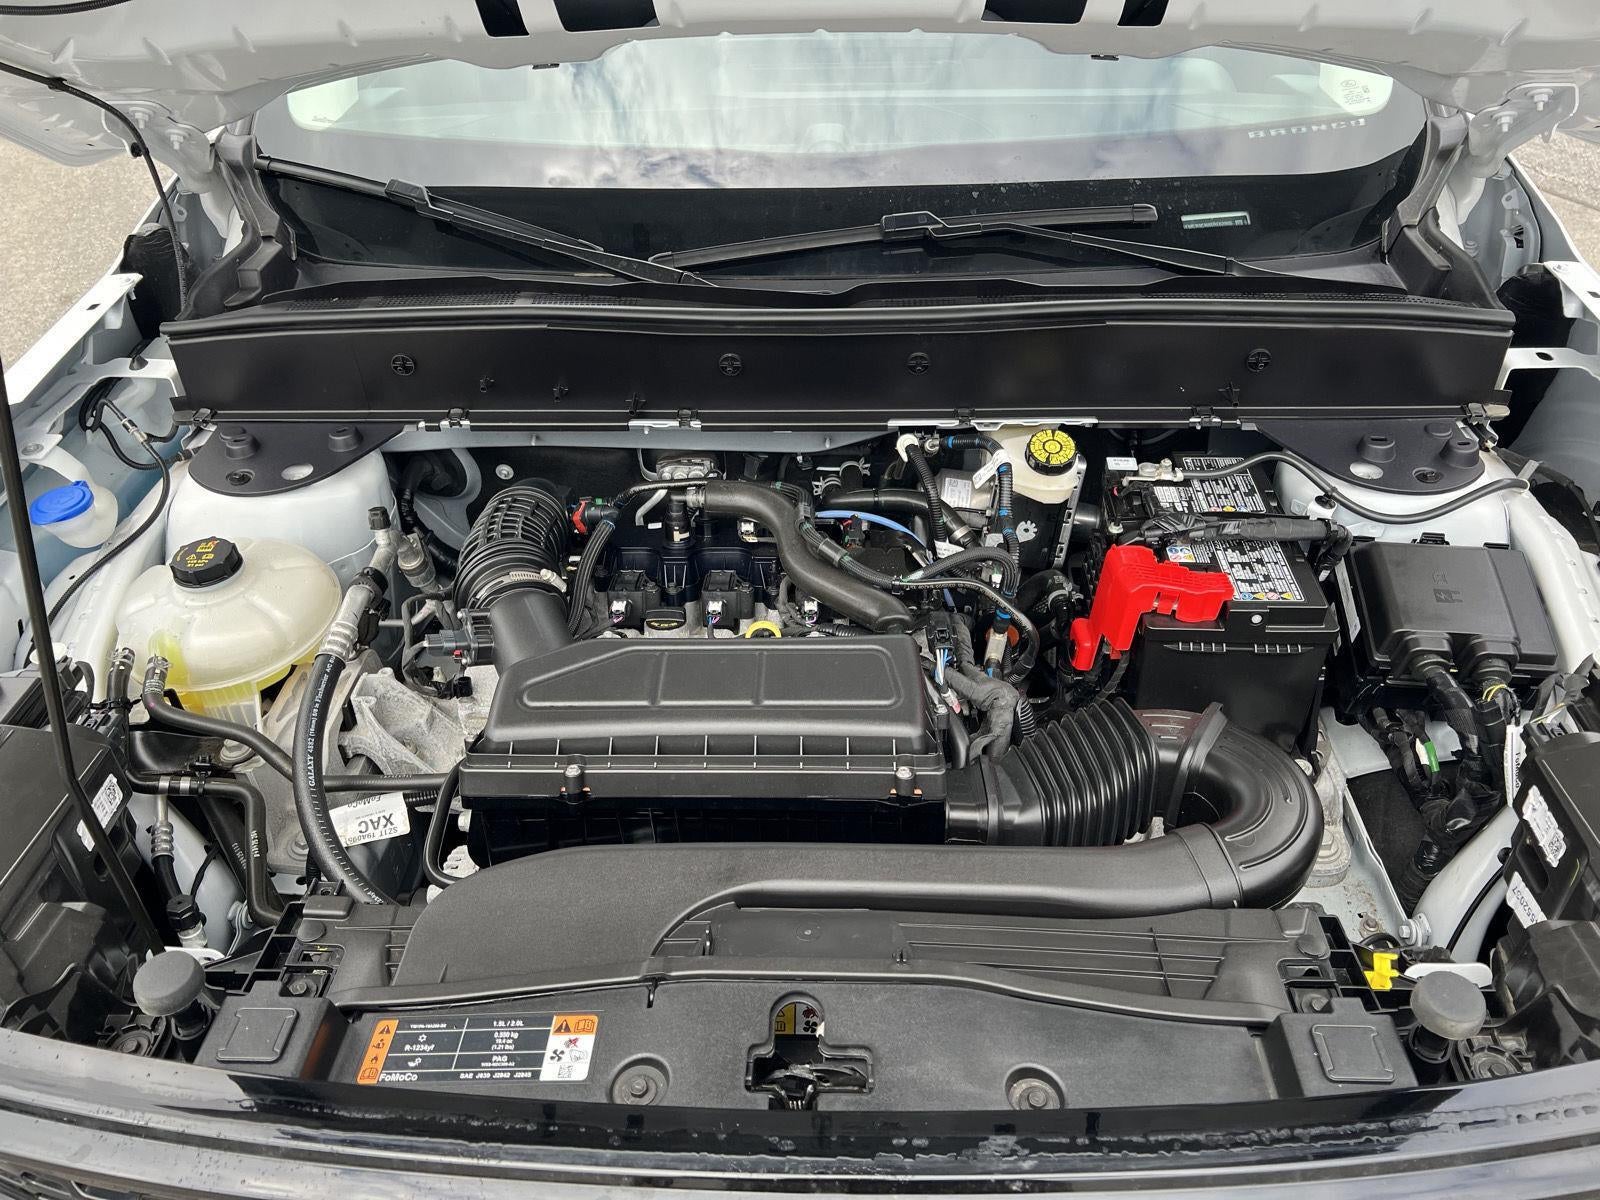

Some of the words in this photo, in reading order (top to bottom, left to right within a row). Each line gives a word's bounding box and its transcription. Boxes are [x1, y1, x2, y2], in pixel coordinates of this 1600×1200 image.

[307, 754, 315, 787] GALAXY
[357, 813, 395, 834] XAC
[1512, 885, 1538, 925] 552037
[404, 1044, 435, 1052] R-1234yf
[379, 1073, 418, 1082] FoMoCo
